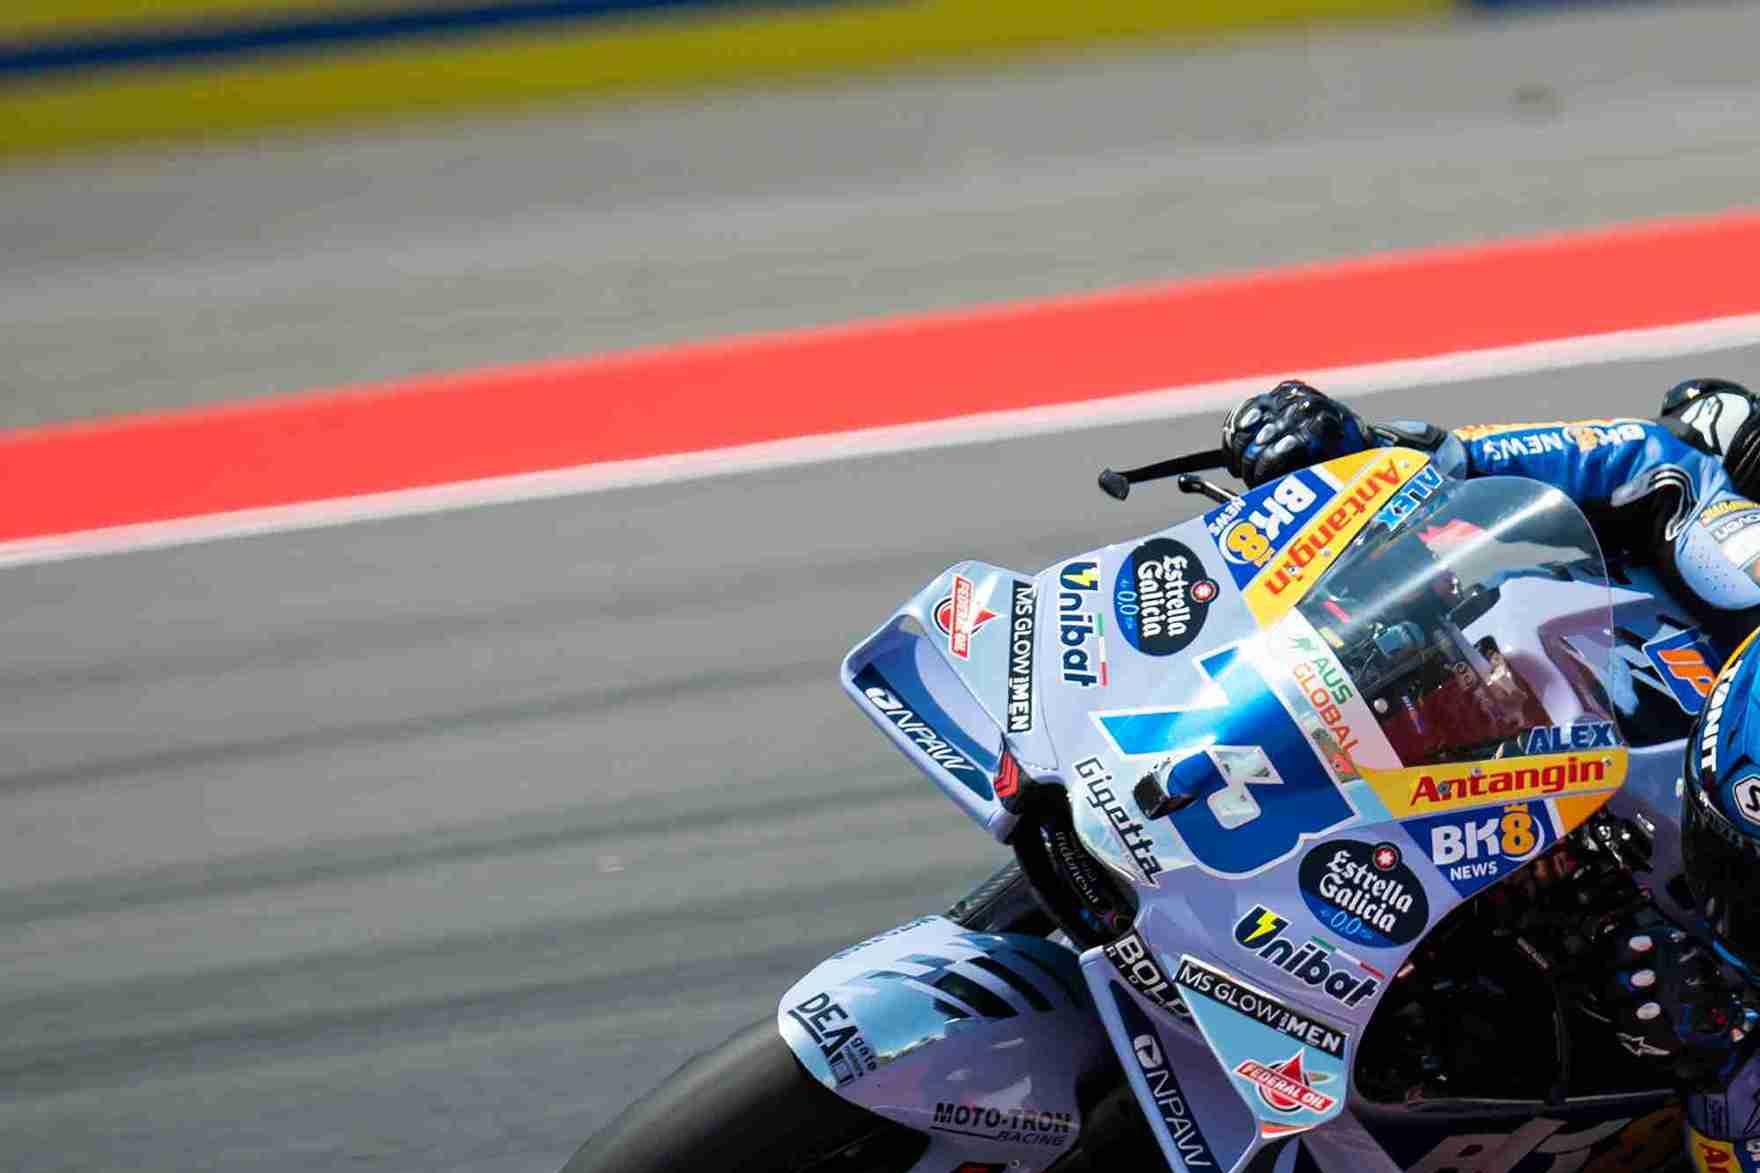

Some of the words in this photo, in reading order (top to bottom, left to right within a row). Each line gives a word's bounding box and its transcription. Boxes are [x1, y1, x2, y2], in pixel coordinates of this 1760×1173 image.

[1484, 428, 1561, 462] NEWS
[1207, 497, 1247, 537] NEWS
[1227, 475, 1318, 567] BK8
[1375, 464, 1444, 533] ALEX
[1263, 458, 1402, 596] Antangin
[1014, 586, 1035, 616] MS
[1058, 560, 1099, 688] Unibat
[1136, 560, 1162, 638] Galicia
[1162, 554, 1193, 638] Estrella
[1012, 615, 1034, 675] GLOW
[1008, 685, 1031, 732] MEN
[1312, 655, 1354, 706] AUS
[1293, 662, 1359, 756] GLOBAL
[1525, 722, 1617, 754] ALEX
[1410, 757, 1606, 806] Antangin
[1431, 813, 1536, 866] BK8
[1326, 849, 1414, 914] Estrella
[1449, 861, 1498, 883] NEWS
[1319, 873, 1398, 933] Galicia
[1235, 904, 1379, 1009] Unibat
[1179, 964, 1212, 991] MS
[1213, 983, 1281, 1022] GLOW
[1284, 1015, 1341, 1053] MEN
[1244, 1064, 1302, 1100] FEDERAL
[933, 1101, 1071, 1133] MOTO-TRON
[998, 1130, 1069, 1147] RACING
